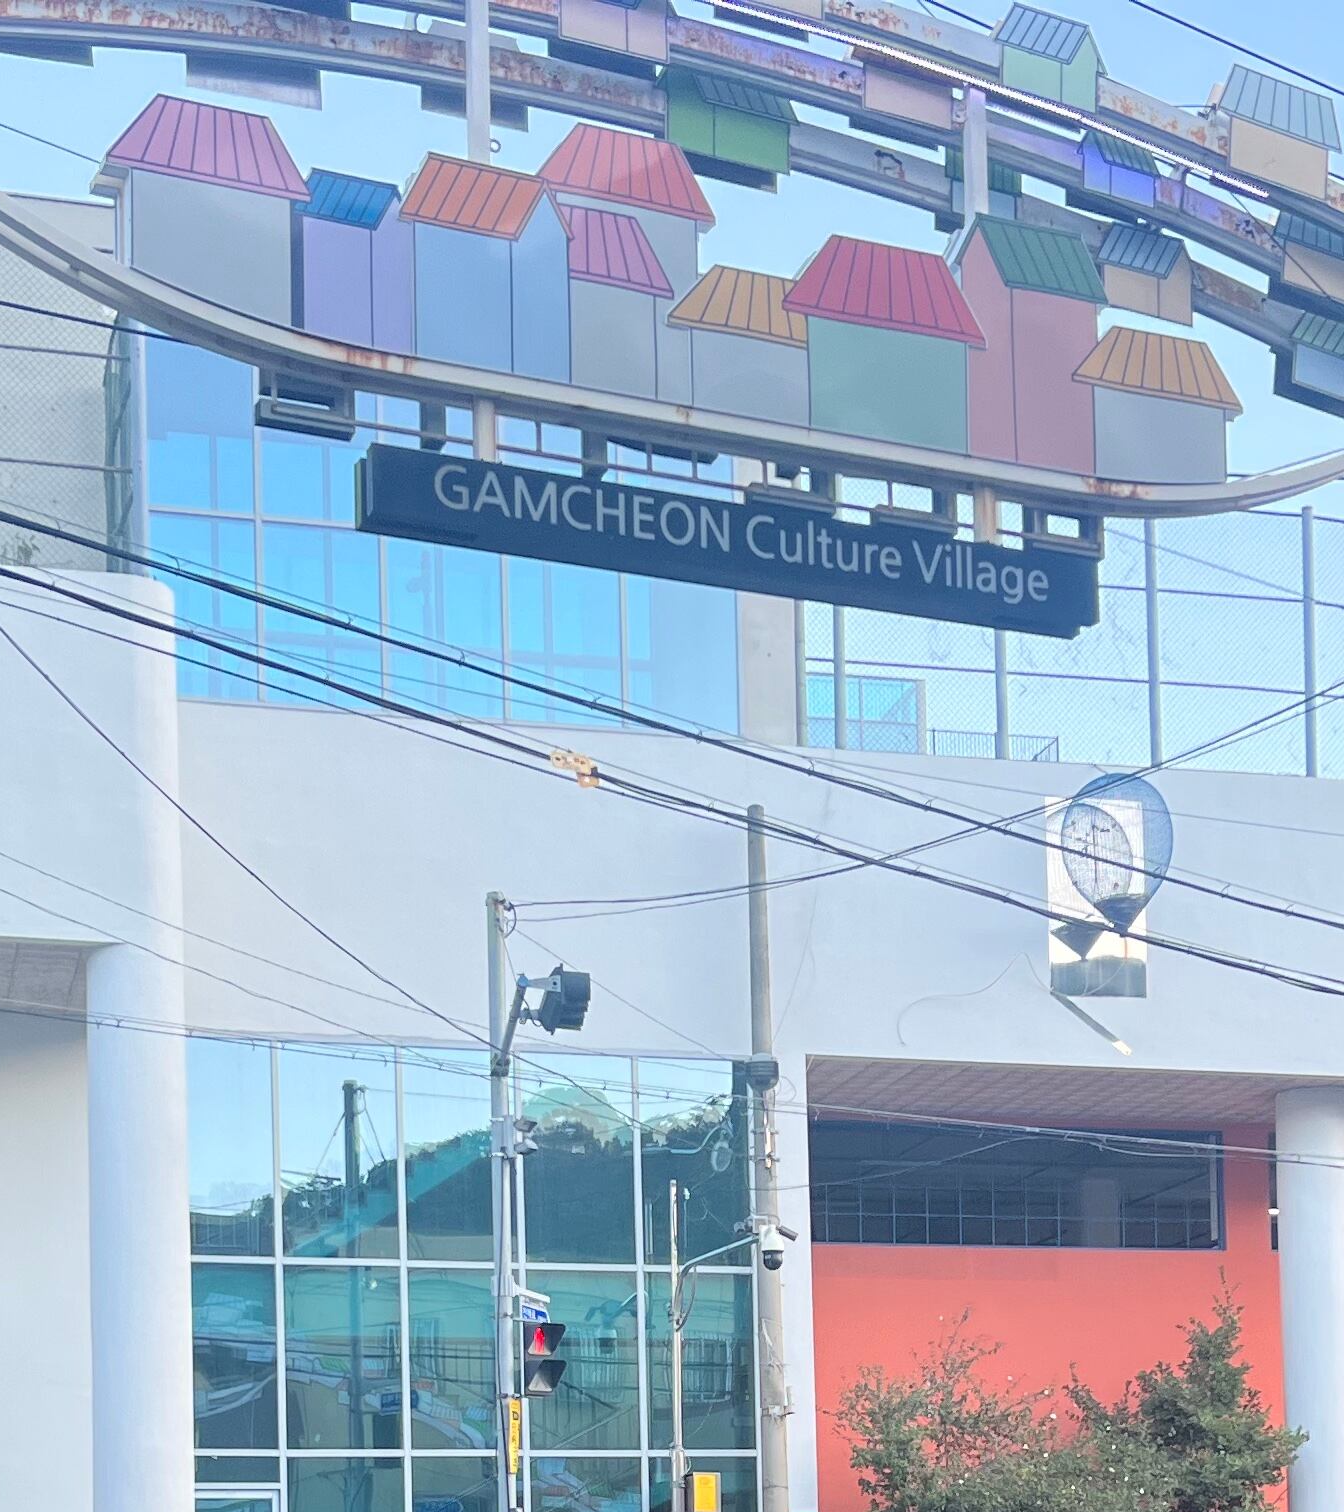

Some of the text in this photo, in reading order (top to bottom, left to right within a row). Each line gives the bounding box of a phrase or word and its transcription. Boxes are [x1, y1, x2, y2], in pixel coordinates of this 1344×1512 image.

[433, 463, 1051, 605] GAMCHEON Culture Village
